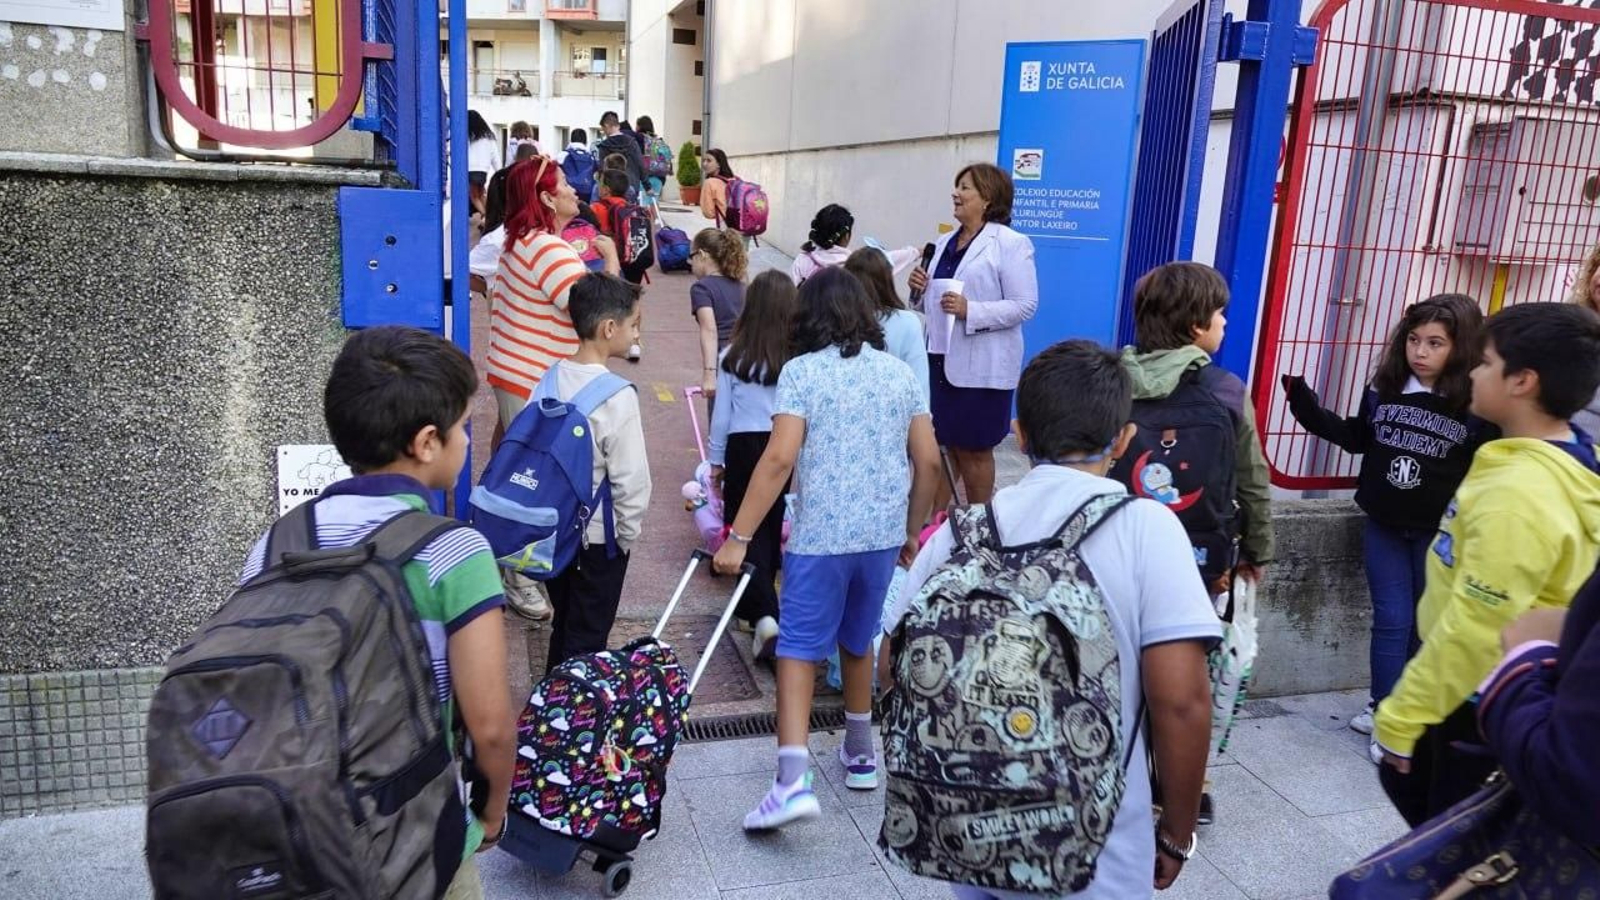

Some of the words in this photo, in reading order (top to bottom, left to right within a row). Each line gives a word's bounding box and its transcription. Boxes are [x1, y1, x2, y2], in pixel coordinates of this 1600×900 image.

[1048, 62, 1096, 75] XUNTA
[1046, 77, 1064, 90] DE
[1068, 76, 1125, 90] GALICIA
[1049, 187, 1101, 198] EDUCACIÓN
[1050, 200, 1057, 208] E
[1058, 199, 1100, 210] PRIMARIA
[1041, 220, 1078, 231] LAXEIRO
[283, 488, 299, 496] YO
[303, 488, 320, 496] ME
